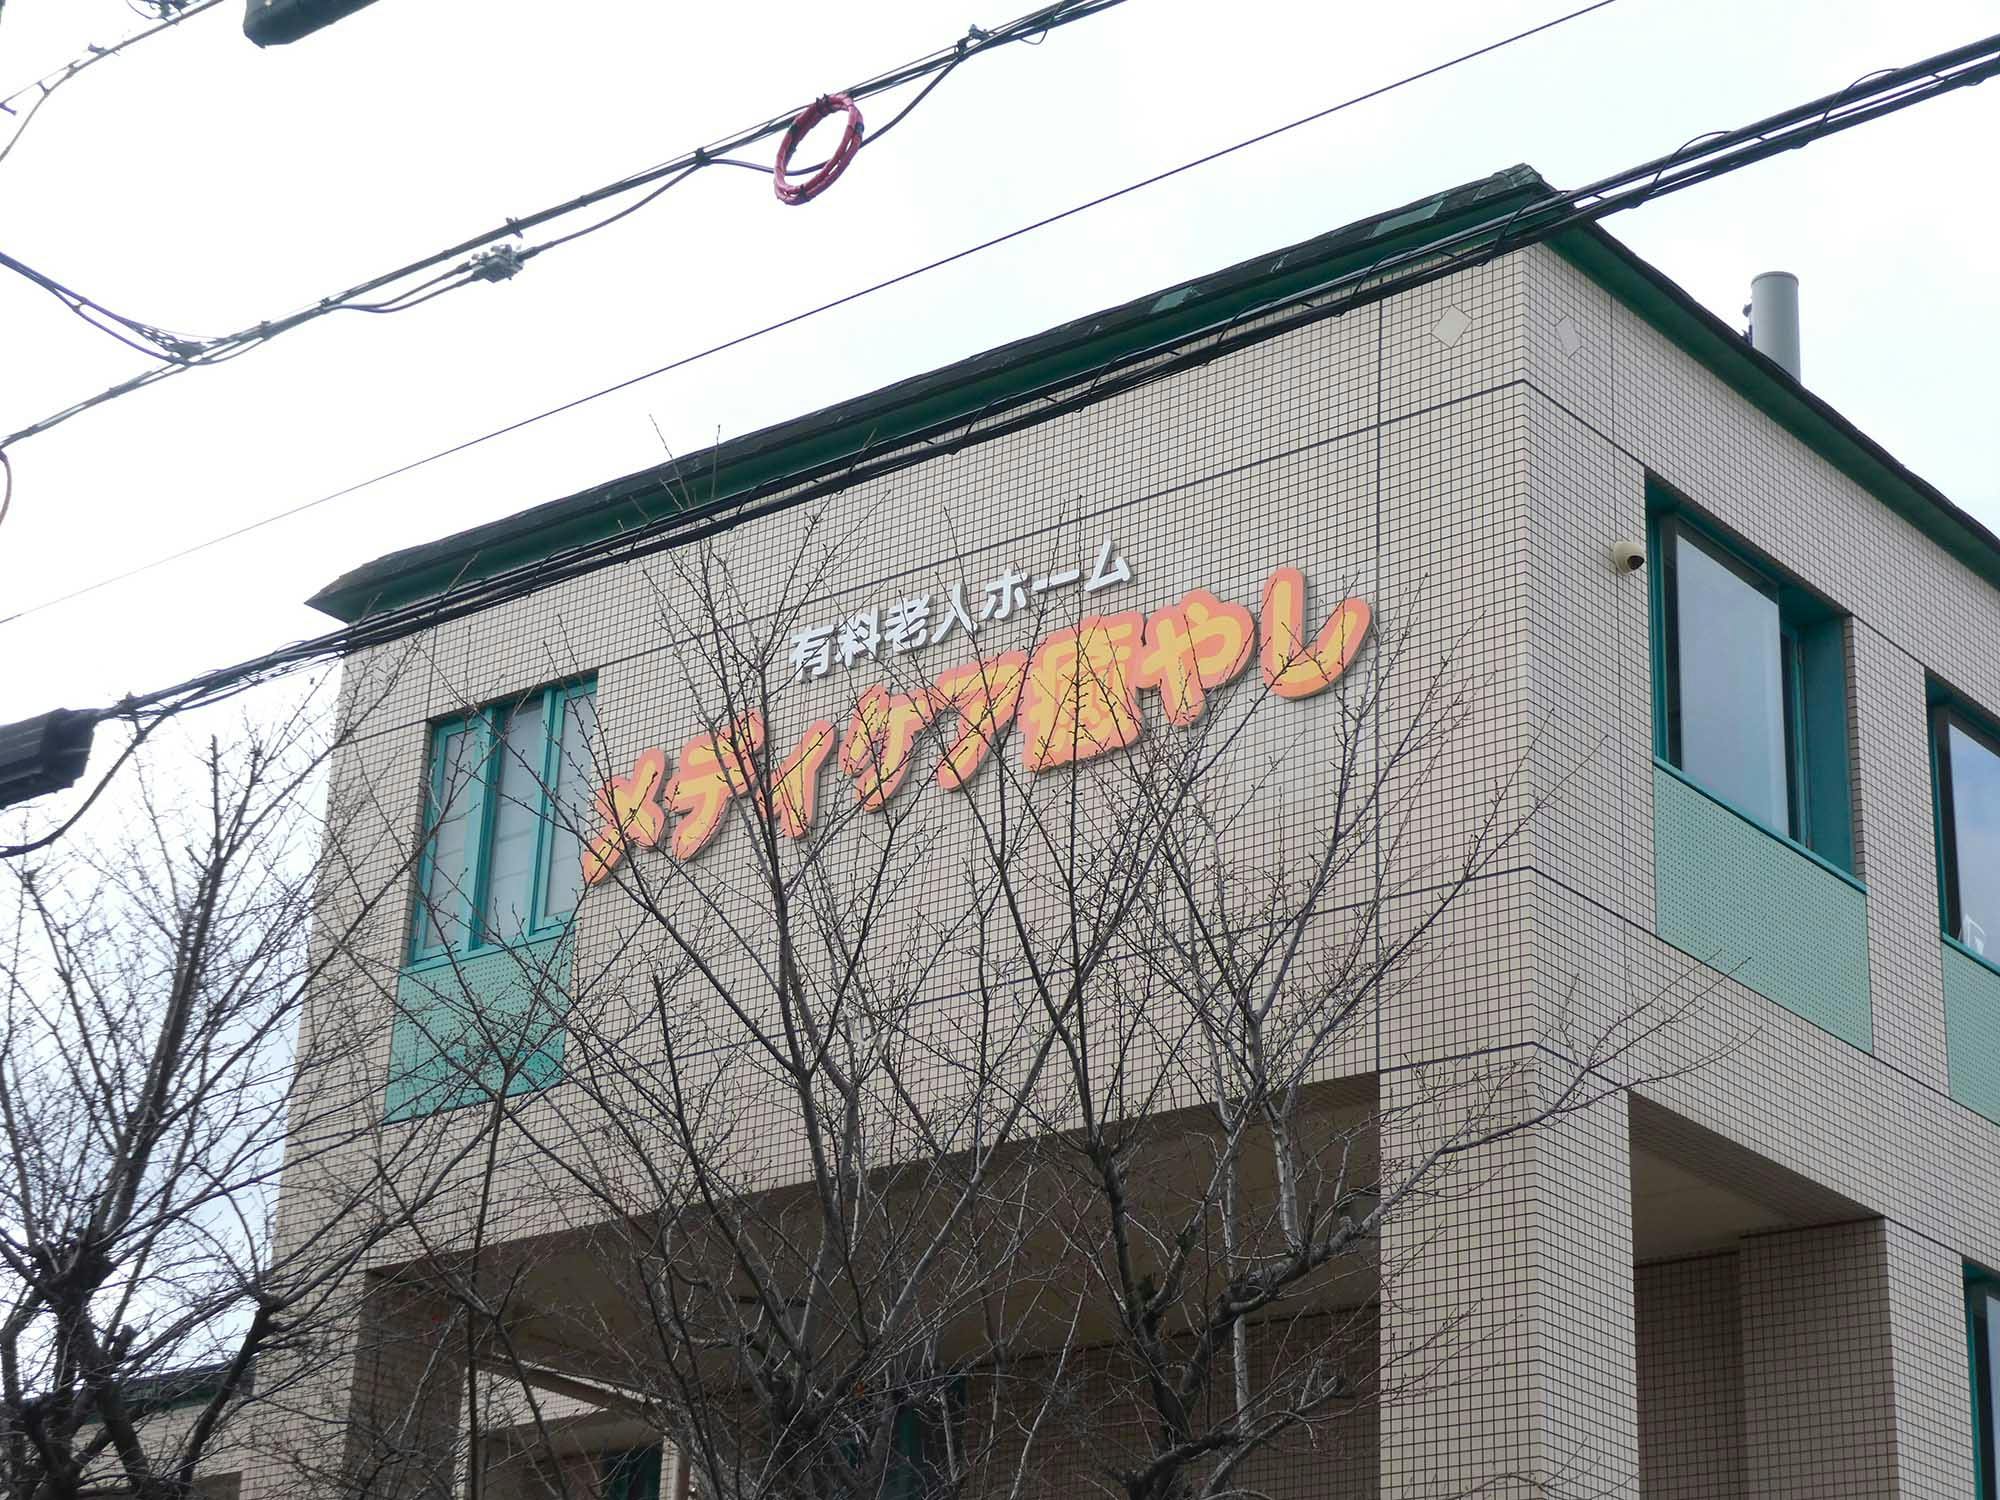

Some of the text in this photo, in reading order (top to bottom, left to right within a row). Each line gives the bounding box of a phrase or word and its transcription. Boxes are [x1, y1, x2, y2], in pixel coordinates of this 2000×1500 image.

[788, 539, 1133, 679] 有料老人ホーム
[581, 566, 1373, 884] メディケア癒やし
